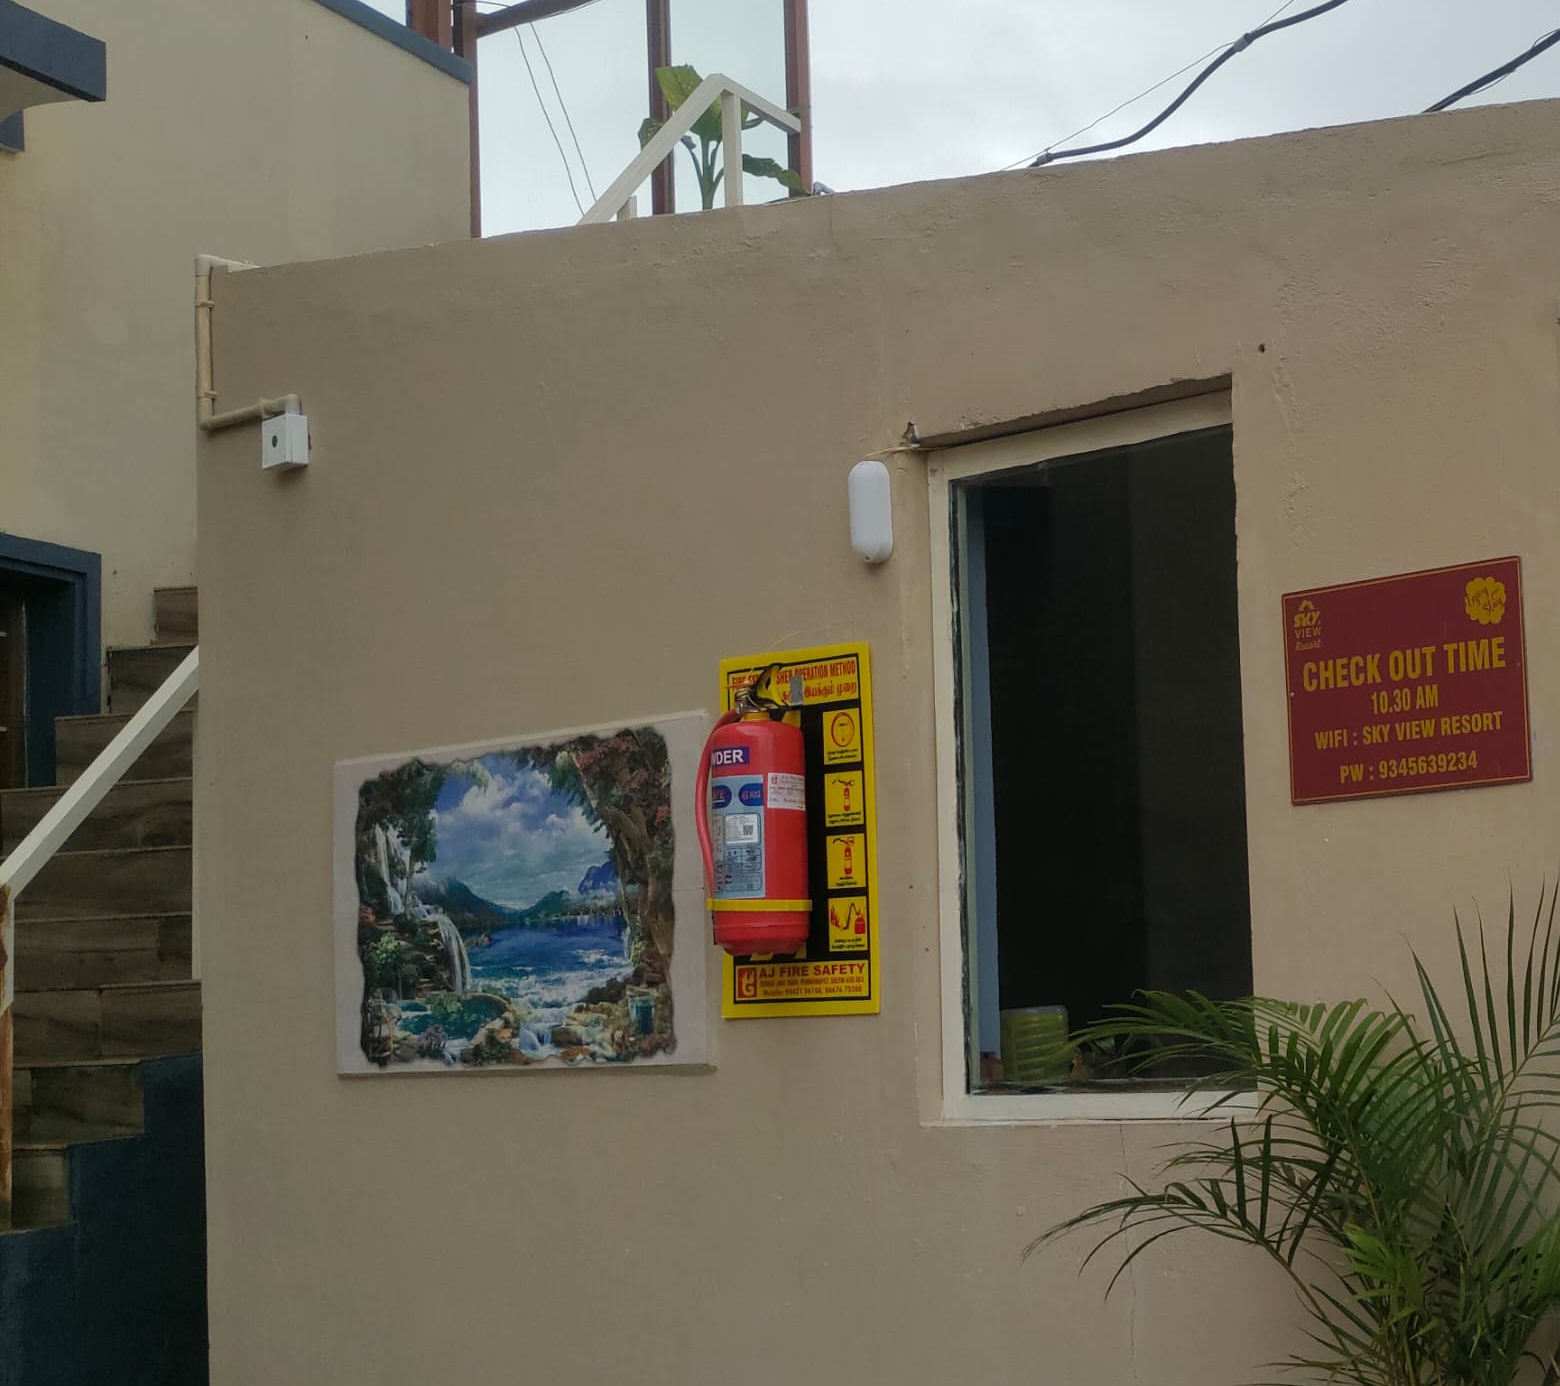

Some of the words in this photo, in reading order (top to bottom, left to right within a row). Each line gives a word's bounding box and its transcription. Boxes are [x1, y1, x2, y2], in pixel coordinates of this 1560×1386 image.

[1295, 625, 1321, 639] VIEW
[829, 659, 855, 677] METHOD
[1302, 652, 1382, 692] CHECK
[1388, 645, 1436, 682] OUT
[1443, 636, 1506, 675] TIME
[1370, 687, 1411, 715] 10.30
[1415, 684, 1439, 709] AM
[1315, 728, 1348, 749] WIFI
[1362, 724, 1391, 745] SKY
[1395, 719, 1436, 741] VIEW
[1440, 711, 1503, 737] RESORT
[1340, 764, 1364, 783] PW
[1379, 750, 1478, 779] 9345639234
[759, 967, 775, 978] AJ
[780, 965, 809, 978] FIRE
[813, 963, 865, 976] SAFETY
